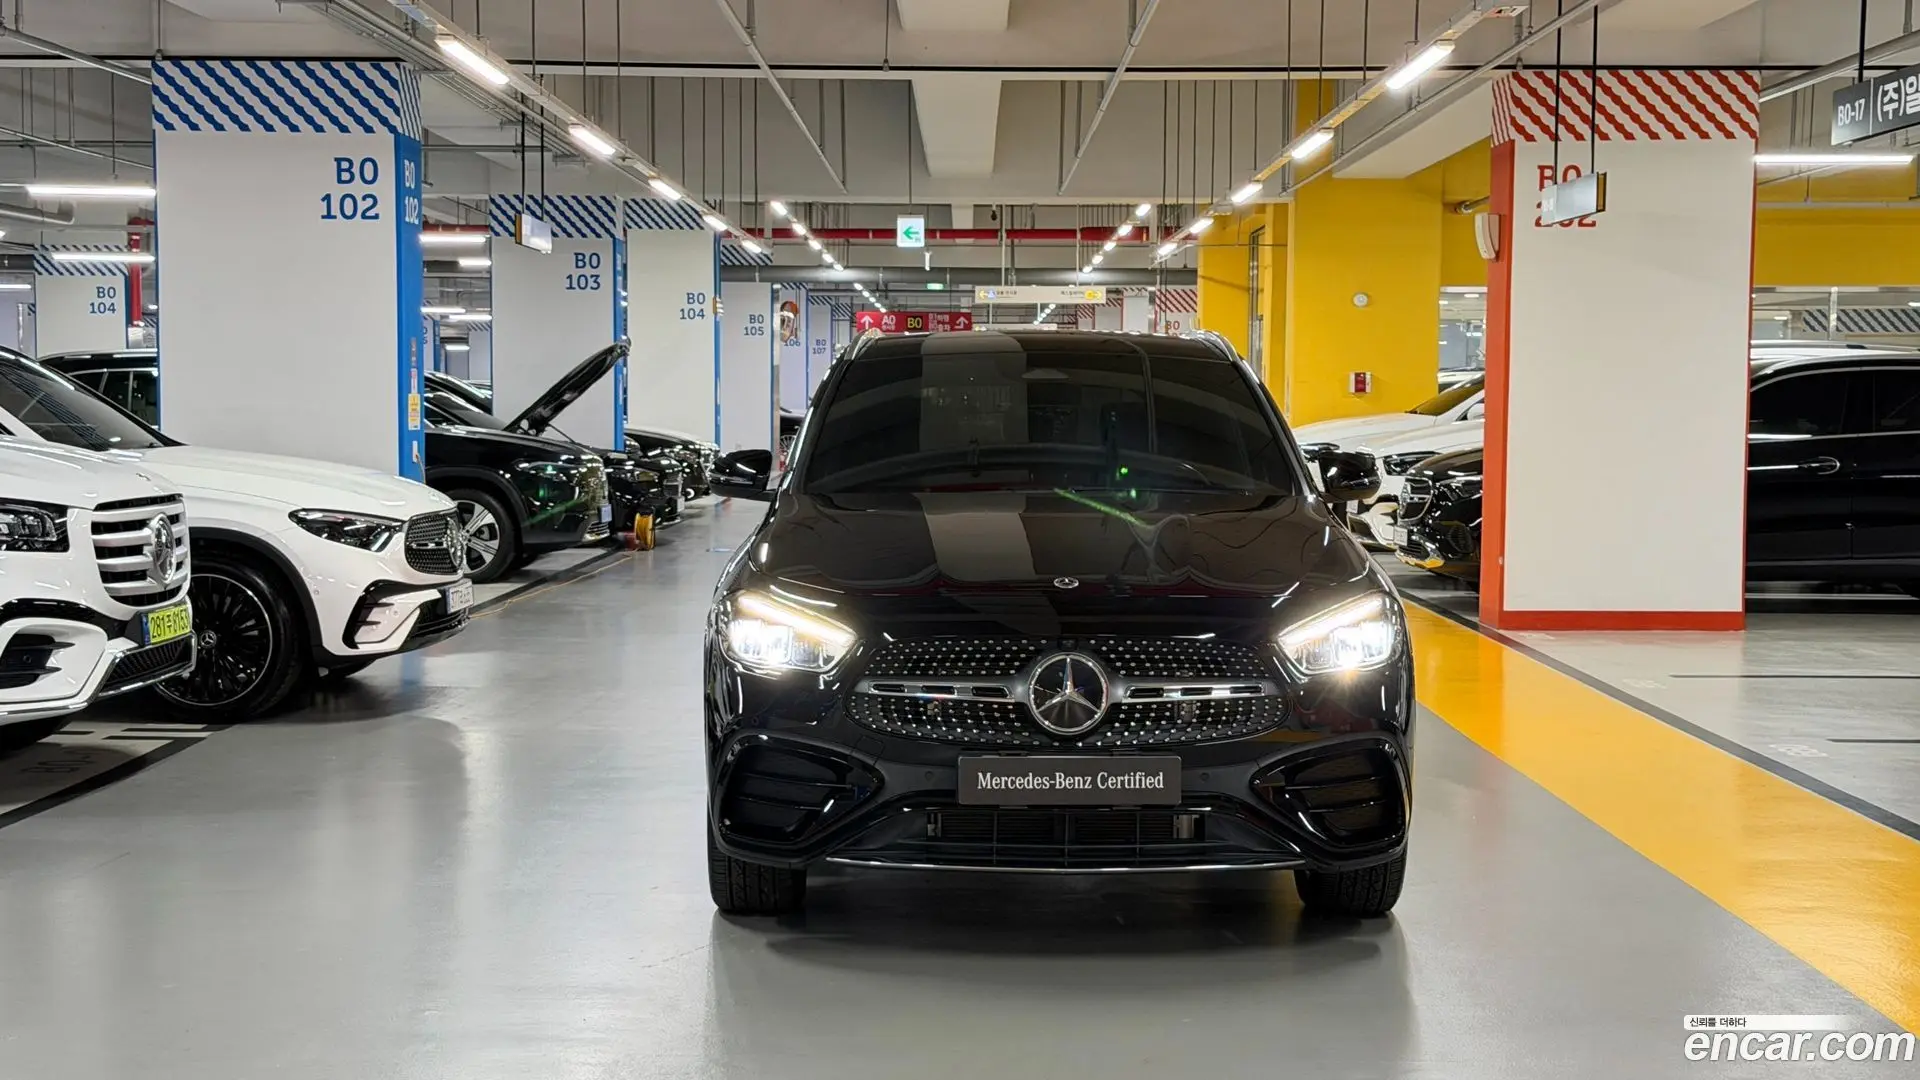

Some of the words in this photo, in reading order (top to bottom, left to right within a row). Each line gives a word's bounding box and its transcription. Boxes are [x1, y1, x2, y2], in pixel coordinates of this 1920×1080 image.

[320, 192, 380, 220] 102
[404, 195, 420, 225] 102
[565, 273, 602, 291] 103
[89, 302, 117, 314] 104
[679, 308, 706, 320] 104
[743, 326, 765, 336] 105
[977, 772, 1092, 789] Mercedes-Benz
[1097, 772, 1165, 789] Certified
